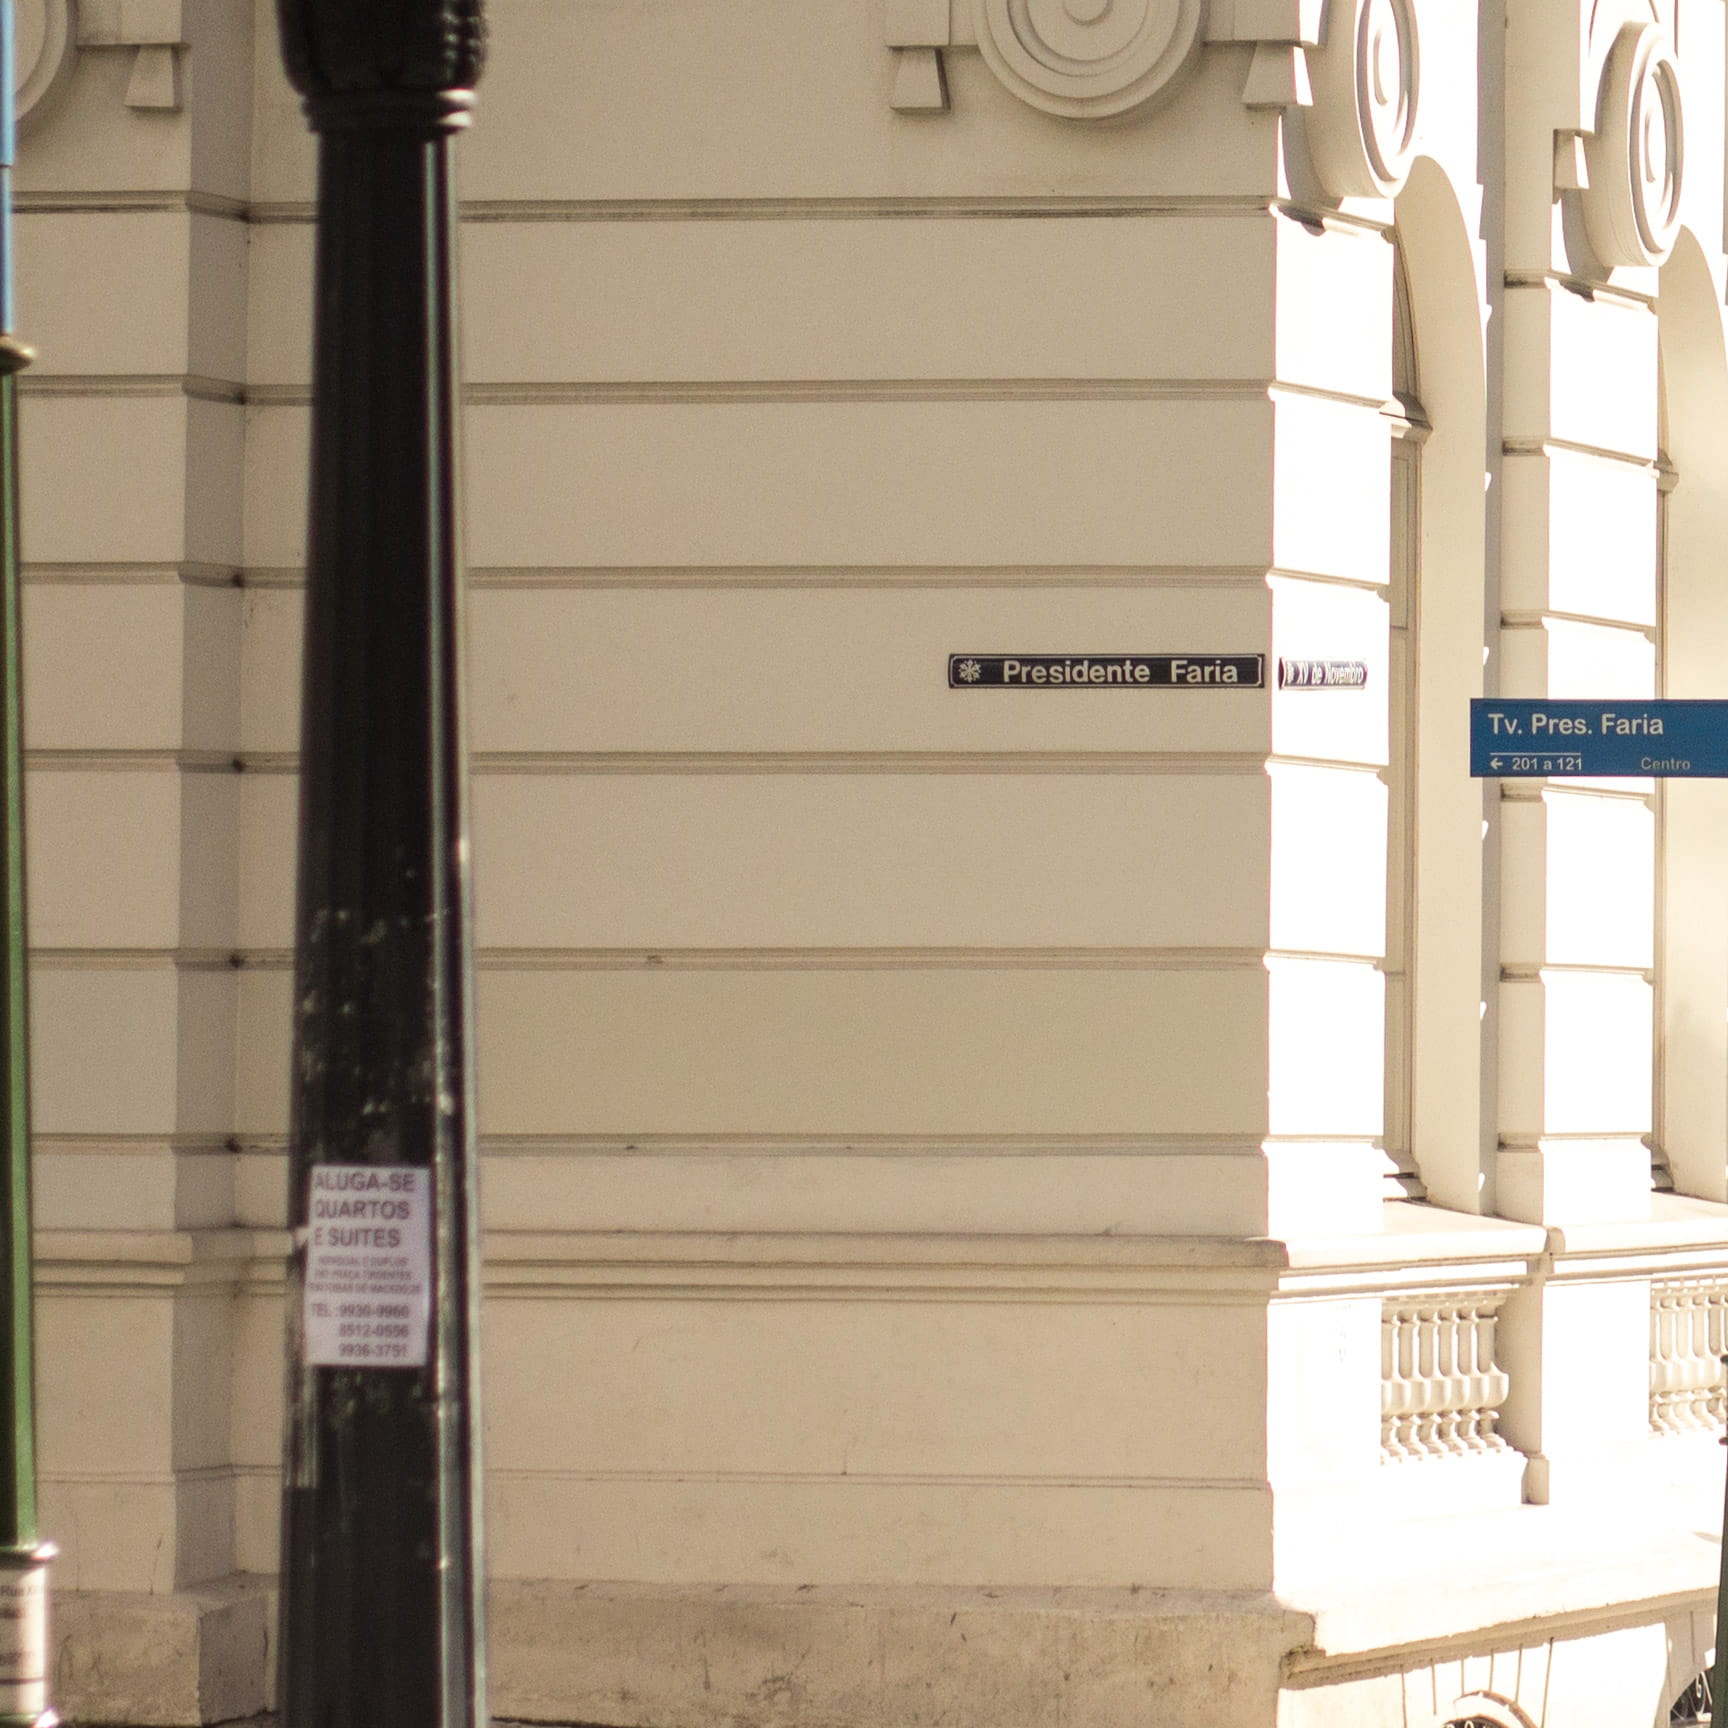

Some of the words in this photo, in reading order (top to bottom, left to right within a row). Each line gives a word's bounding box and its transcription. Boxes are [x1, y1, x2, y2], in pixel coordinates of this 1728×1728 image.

[1002, 660, 1151, 684] Presidente
[1170, 660, 1238, 684] Faria
[1487, 713, 1522, 735] Tv.
[1531, 713, 1593, 735] Pres.
[1601, 713, 1664, 735] Faria
[1511, 757, 1539, 771] 201
[1543, 760, 1553, 771] a
[1556, 757, 1583, 771] 121
[1640, 757, 1691, 771] Centro
[315, 1172, 415, 1193] ALUGA-SE
[315, 1200, 411, 1220] QUARTOS
[314, 1227, 323, 1246] E
[327, 1227, 400, 1248] SUITES
